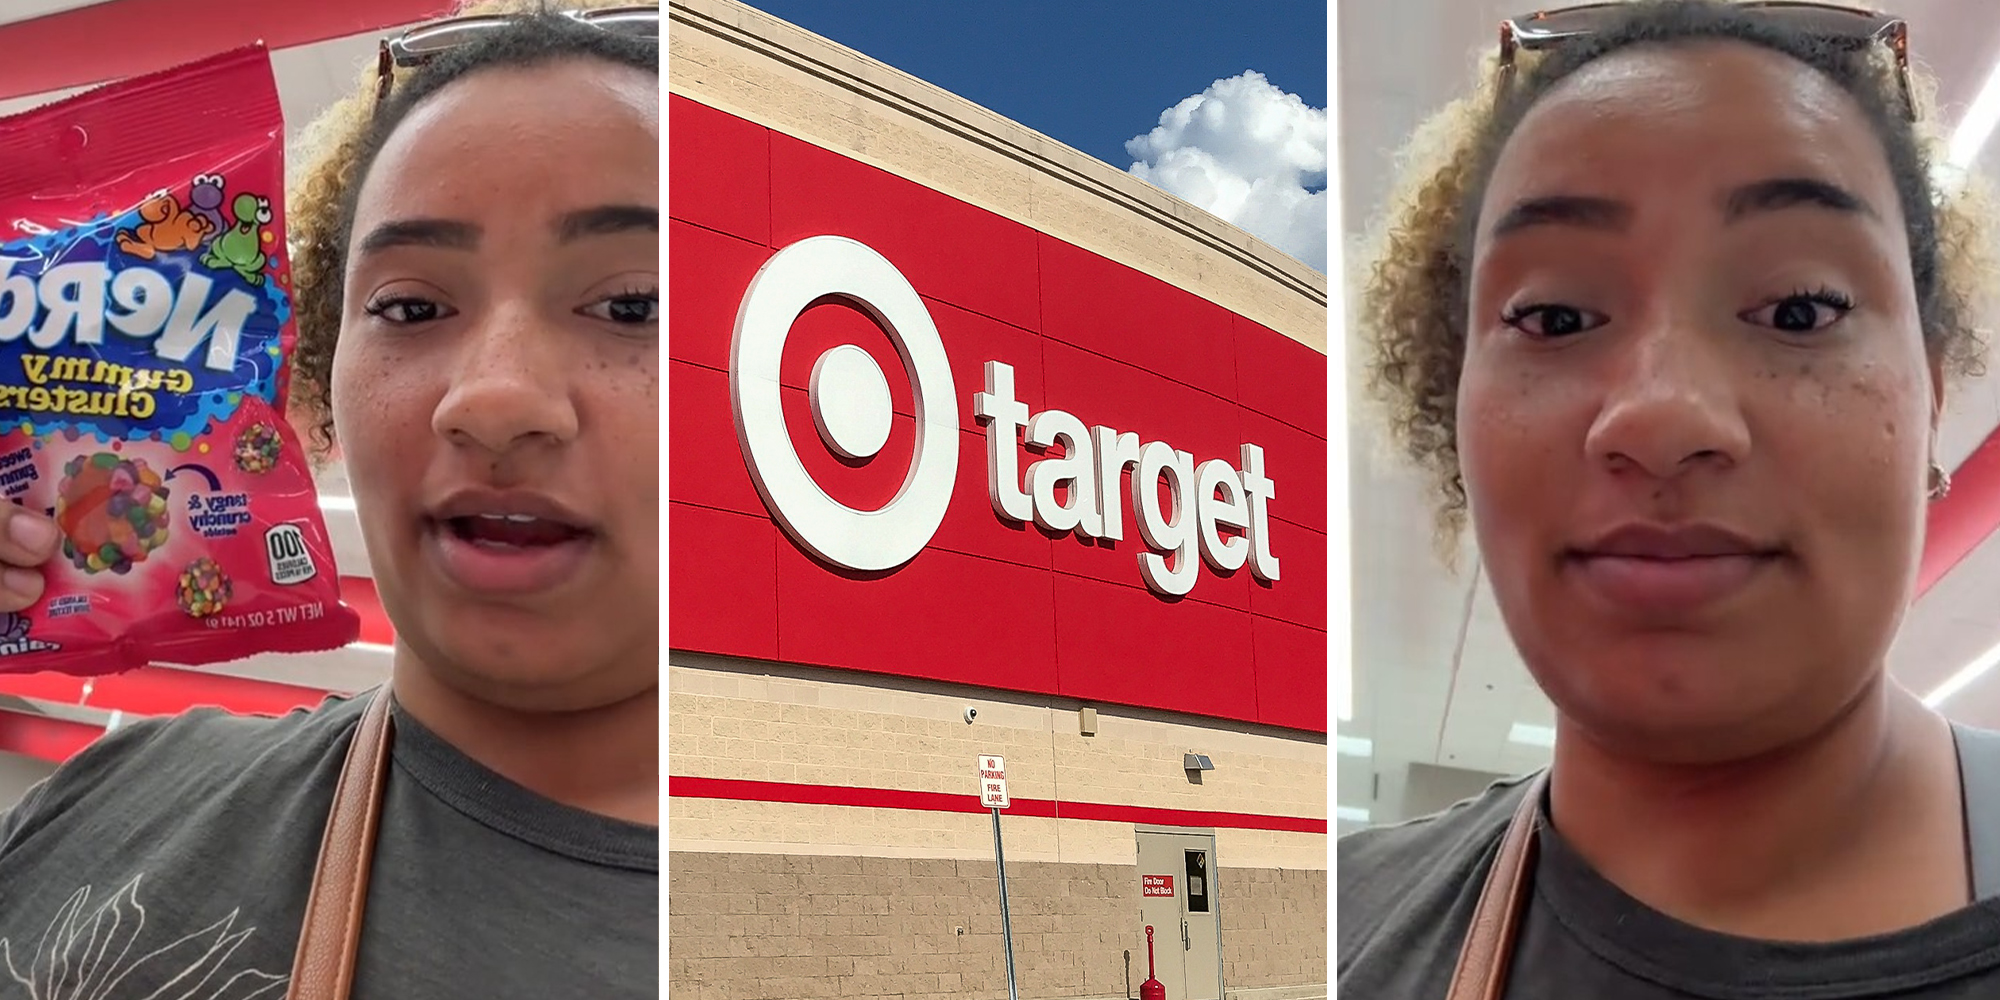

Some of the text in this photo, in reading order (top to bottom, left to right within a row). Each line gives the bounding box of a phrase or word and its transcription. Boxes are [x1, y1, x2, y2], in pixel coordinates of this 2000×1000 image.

[974, 360, 1280, 595] target
[987, 759, 996, 769] NO
[980, 769, 1005, 780] PARKING
[987, 784, 1001, 792] FIRE
[987, 794, 1003, 802] LANE
[1153, 877, 1164, 885] Door
[1160, 887, 1172, 895] Block
